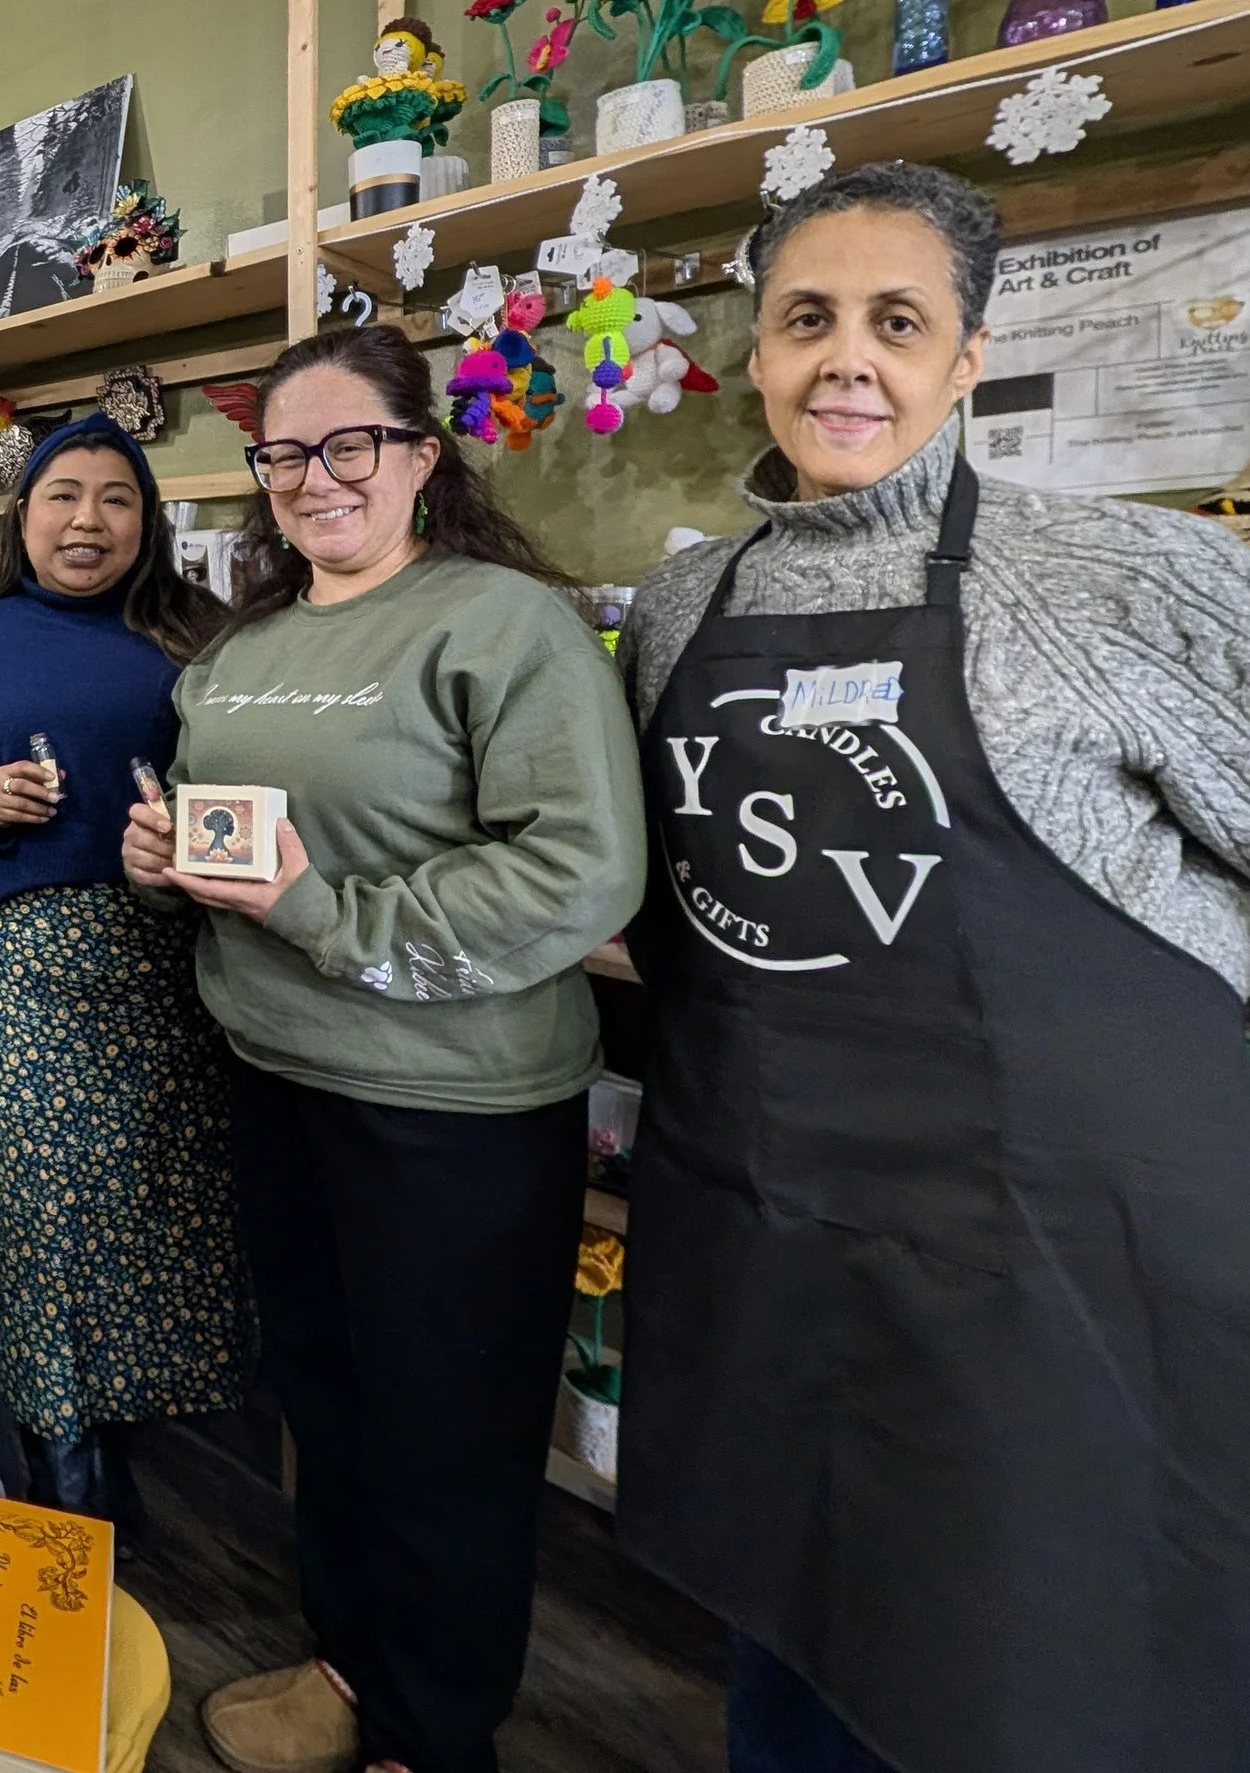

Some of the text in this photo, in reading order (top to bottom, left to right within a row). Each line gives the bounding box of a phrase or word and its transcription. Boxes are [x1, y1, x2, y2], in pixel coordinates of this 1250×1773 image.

[998, 234, 1161, 275] Exhibition of
[998, 260, 1132, 295] Art & Craft
[989, 314, 1140, 345] he Knitting Peach
[227, 694, 254, 714] my
[253, 682, 299, 705] heart
[313, 694, 342, 715] my
[676, 860, 770, 948] & GIFTS
[8, 1602, 40, 1694] El libro de las
